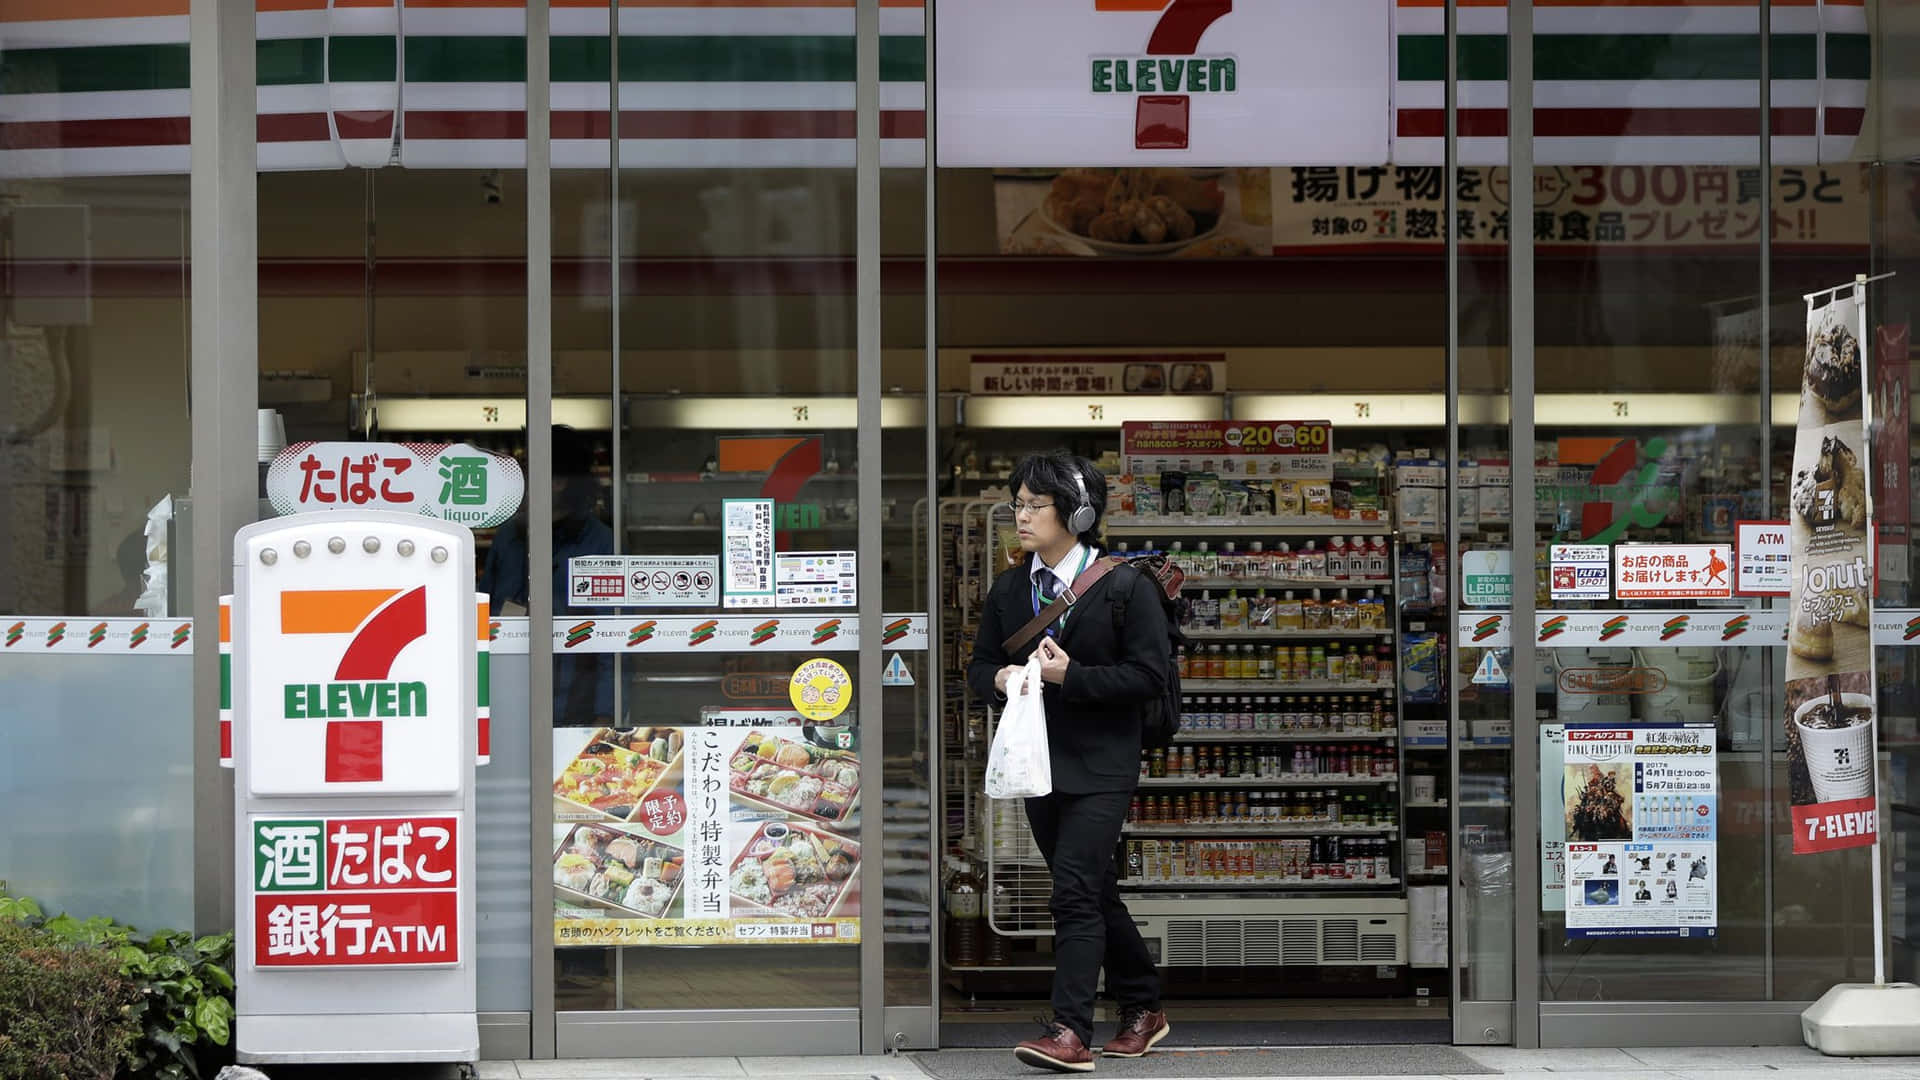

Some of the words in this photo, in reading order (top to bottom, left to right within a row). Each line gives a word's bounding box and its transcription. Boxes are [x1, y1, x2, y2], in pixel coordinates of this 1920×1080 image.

[1243, 427, 1273, 446] 20
[1296, 427, 1325, 446] 60
[300, 453, 414, 504] たばこ
[438, 456, 488, 505] 酒
[443, 508, 488, 522] liquor
[1757, 533, 1785, 545] ATM
[1330, 558, 1342, 571] in
[1350, 558, 1362, 571] in
[1370, 558, 1382, 571] in
[1622, 555, 1689, 568] お店の商品
[1580, 578, 1605, 586] SPOT
[1812, 609, 1844, 626] ドーナツ
[1646, 732, 1700, 744] 紅蓮の解放者
[1568, 744, 1588, 755] FINAL
[1591, 744, 1620, 755] FANTASY
[645, 799, 667, 831] 限定
[663, 795, 683, 825] 予約
[700, 731, 723, 913] こだわり特製弁当
[1805, 809, 1876, 841] 7-ELEVE
[259, 826, 321, 888] 酒
[330, 821, 452, 885] たばこ
[267, 903, 446, 956] 銀行ATM
[559, 926, 731, 938] 店頭のパンフレットをご覧ください。
[738, 926, 766, 937] セブン
[769, 926, 809, 937] 特製弁当
